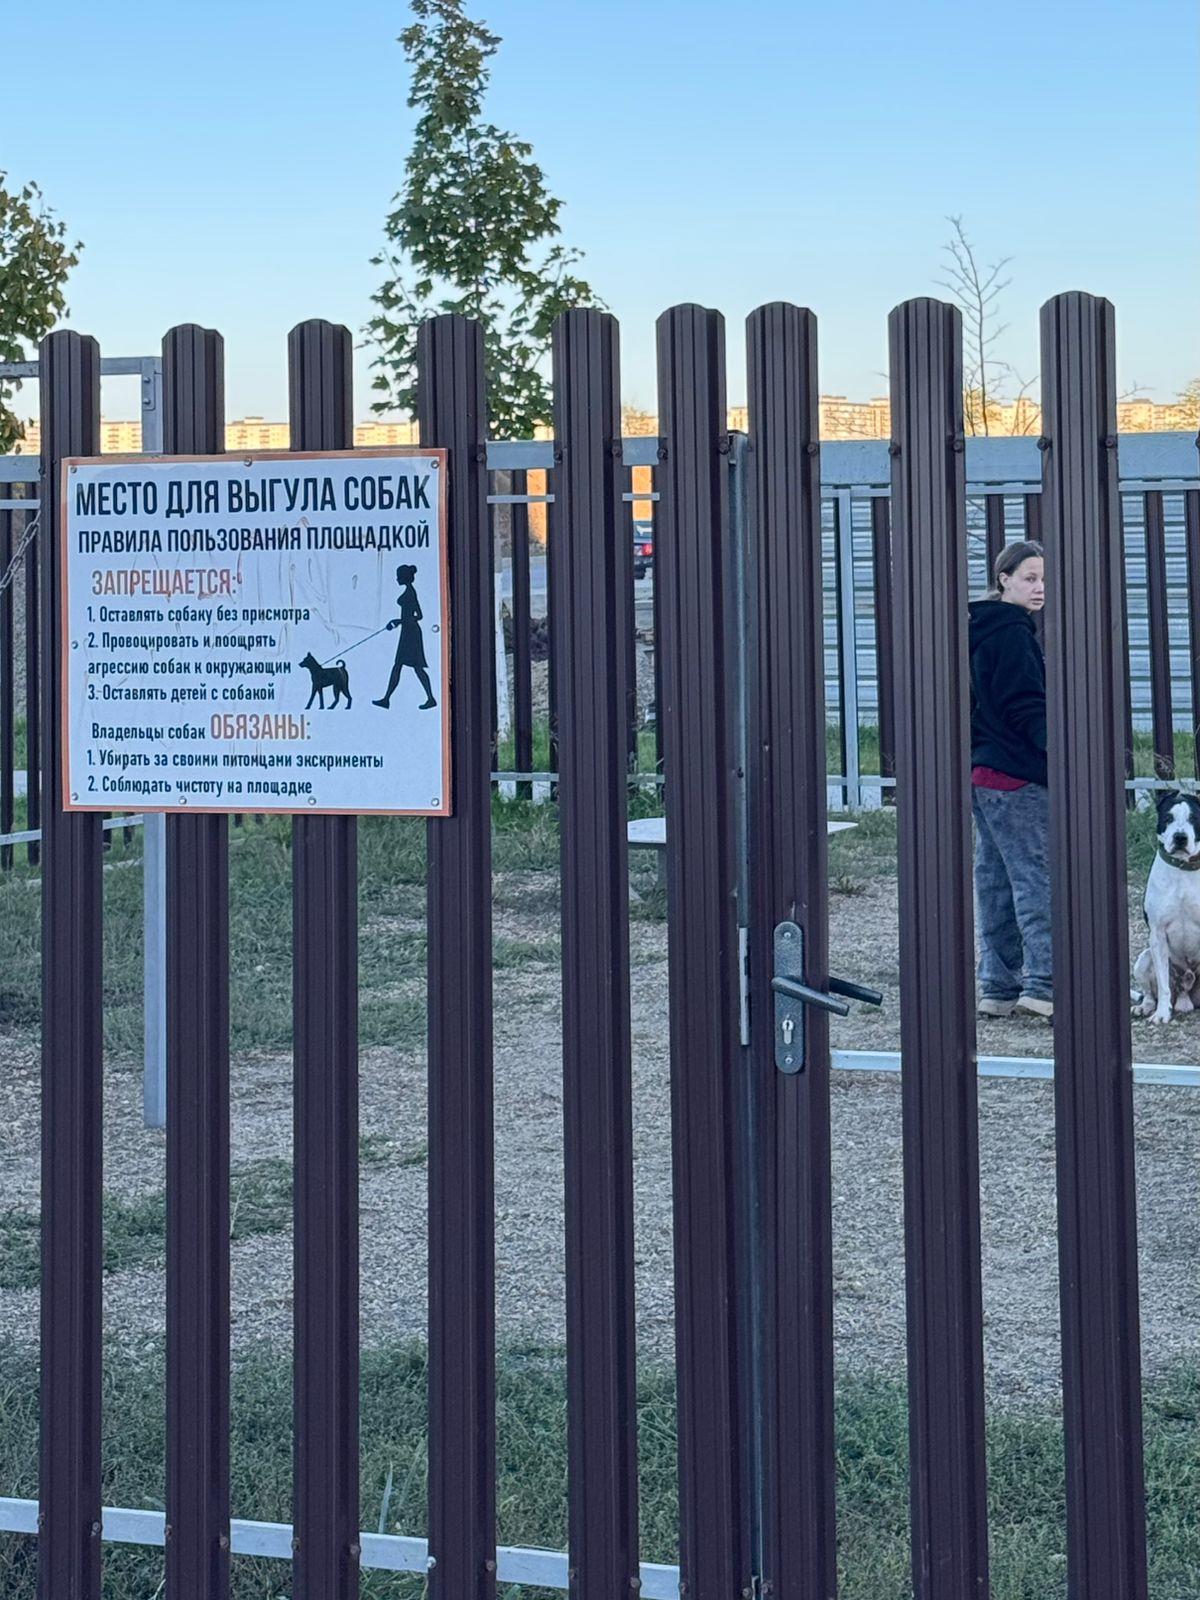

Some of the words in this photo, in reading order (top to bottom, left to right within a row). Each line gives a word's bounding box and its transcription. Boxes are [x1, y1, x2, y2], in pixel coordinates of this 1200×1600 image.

[76, 481, 157, 516] МЕСТО
[165, 480, 219, 518] ДЛЯ
[228, 477, 336, 513] ВЫГУЛА
[344, 475, 430, 510] СОБАК
[79, 530, 161, 553] ПРАВИЛА
[168, 527, 301, 552] ПОЛЬЗОВАНИЯ
[308, 520, 430, 551] ПЛОЩАДКОЙ
[92, 568, 237, 597] ЗАПРЕЩАЕТСЯ:
[87, 606, 95, 622] 1.
[99, 606, 164, 622] Оставлять
[168, 607, 212, 625] собаку
[217, 605, 238, 621] без
[242, 607, 310, 624] присмотра
[88, 632, 98, 648] 2.
[102, 633, 198, 651] Провоцировать
[203, 635, 210, 648] и
[214, 634, 276, 651] поощрять
[88, 661, 149, 677] агрессию
[153, 659, 191, 675] собак
[195, 661, 202, 674] к
[206, 660, 291, 677] окружающим
[102, 685, 167, 701] Оставлять
[171, 683, 207, 702] детей
[211, 687, 218, 700] с
[222, 682, 275, 700] собакой
[92, 723, 164, 741] Владельцы
[168, 724, 205, 740] собак
[210, 713, 311, 740] ОБЯЗАНЫ:
[87, 750, 95, 766] 1.
[99, 749, 151, 769] Убирать
[155, 753, 168, 766] за
[172, 752, 218, 767] своими
[222, 752, 292, 769] питомцами
[296, 753, 383, 770] экскрименты
[88, 775, 98, 792] 2.
[102, 775, 172, 794] Соблюдать
[176, 779, 224, 796] чистоту
[228, 780, 243, 794] на
[247, 779, 312, 795] площадке
